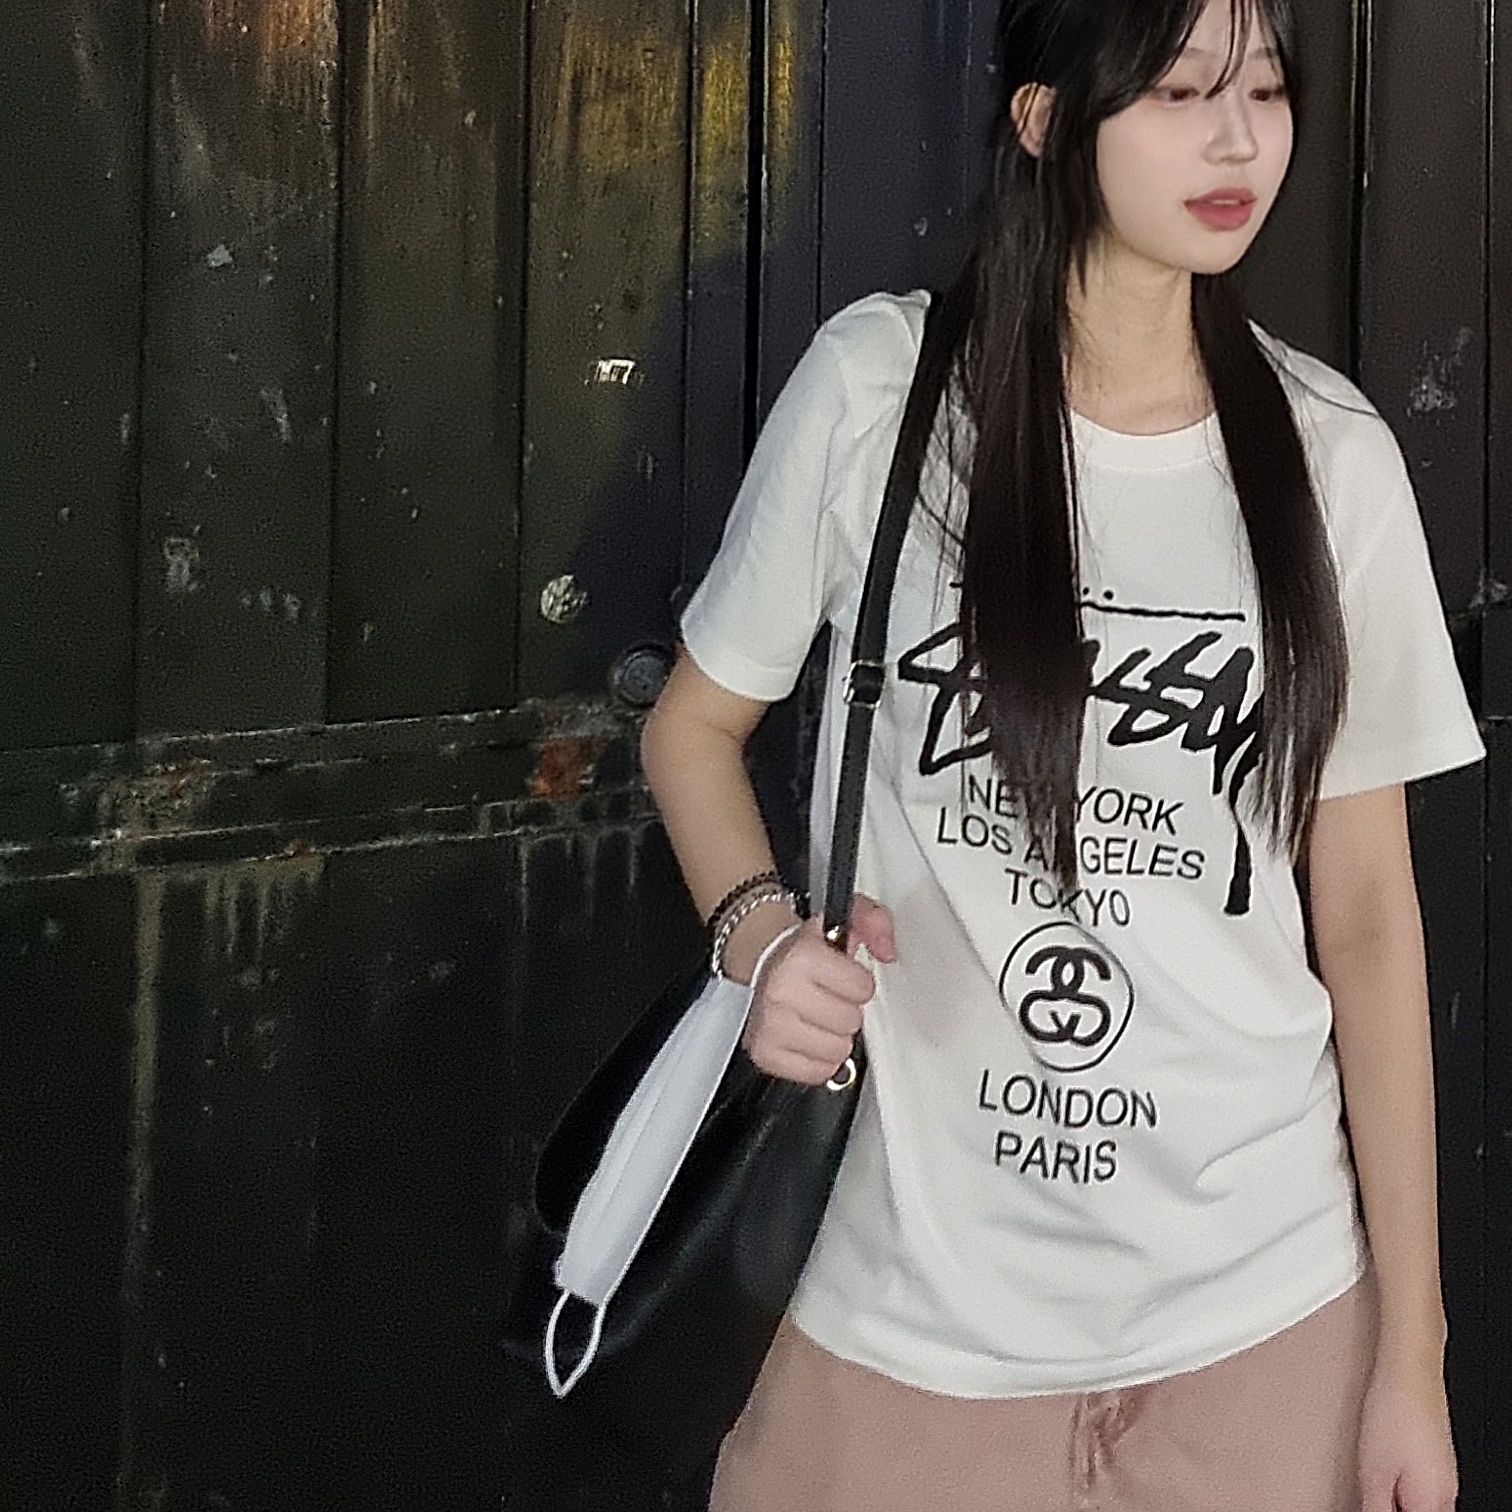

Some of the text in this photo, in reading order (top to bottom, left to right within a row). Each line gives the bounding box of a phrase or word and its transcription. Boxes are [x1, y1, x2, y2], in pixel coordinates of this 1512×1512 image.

[968, 774, 1058, 824] NE
[937, 806, 1206, 880] LOS AGELES
[1004, 867, 1131, 926] TOKYO
[979, 1069, 1158, 1129] LONDON
[995, 1130, 1117, 1184] PARIS
